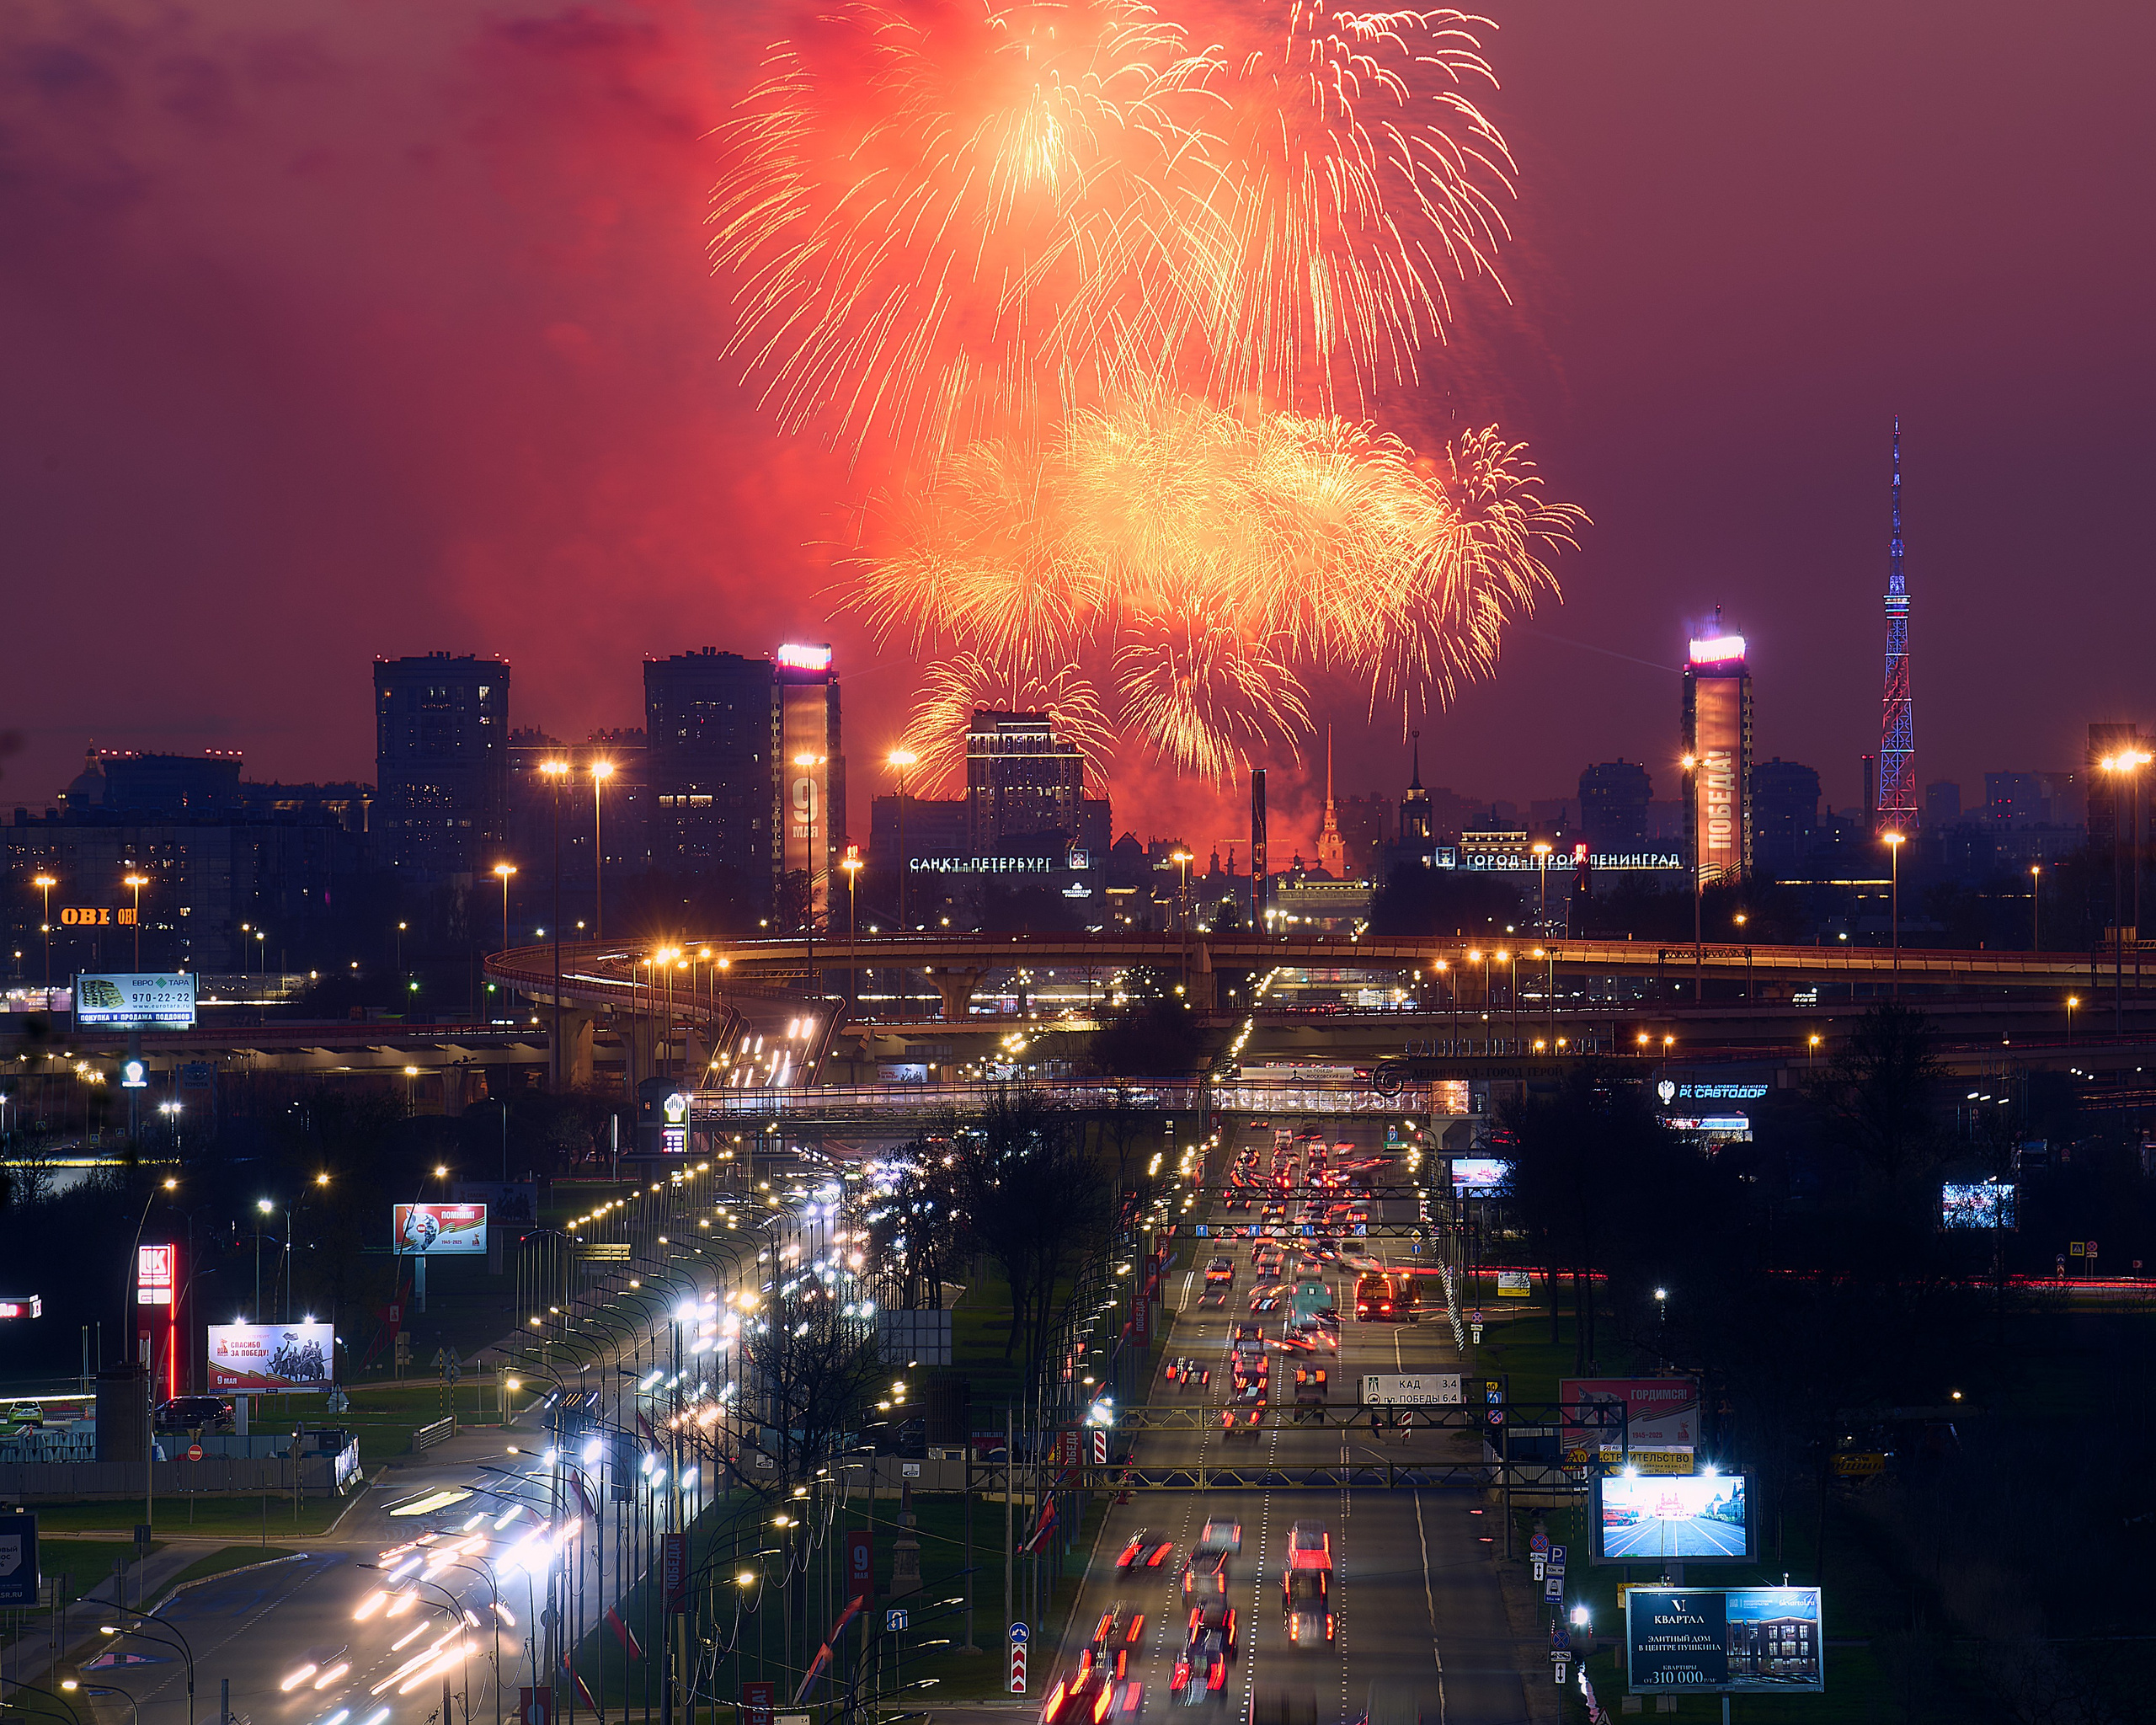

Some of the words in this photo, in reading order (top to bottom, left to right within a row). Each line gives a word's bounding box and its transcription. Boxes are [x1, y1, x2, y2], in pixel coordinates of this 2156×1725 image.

[792, 777, 819, 823] 9
[1708, 750, 1735, 849] ПОБЕДА!
[792, 825, 819, 838] МАЯ
[910, 857, 1052, 870] САНКТ-ПЕТЕРБУРГ
[61, 908, 110, 925] OBI
[118, 908, 136, 925] OBI
[132, 993, 189, 1002] 970-22-22
[1412, 1067, 1478, 1080] ЛЕНИНГРАД
[1486, 1067, 1523, 1079] ГОРОД
[1527, 1064, 1563, 1077] ГЕРОЙ
[440, 1210, 475, 1220] ПОМНИМ!
[1131, 1262, 1140, 1277] 9
[1135, 1298, 1145, 1332] ПОБЕДА!
[216, 1375, 223, 1385] 9
[1399, 1380, 1421, 1390] КАД
[1442, 1380, 1457, 1389] 3,4
[1399, 1395, 1440, 1404] ПОБЕДЫ
[1443, 1394, 1458, 1403] 6,4
[1630, 1389, 1688, 1402] ГОРДИМСЯ!
[1603, 1452, 1689, 1463] СТРИТЕЛЬСТВО
[853, 1546, 868, 1571] 9
[854, 1572, 868, 1580] МАЯ
[1654, 1616, 1705, 1625] КВАРТАЛ
[1647, 1634, 1690, 1643] ЭЛИТНЫЙ
[1691, 1635, 1711, 1643] ДОМ
[1645, 1644, 1677, 1653] ЦЕНТРЕ
[1678, 1643, 1721, 1652] ПУШКИНА
[1652, 1671, 1674, 1684] 310
[1677, 1671, 1704, 1684] 000
